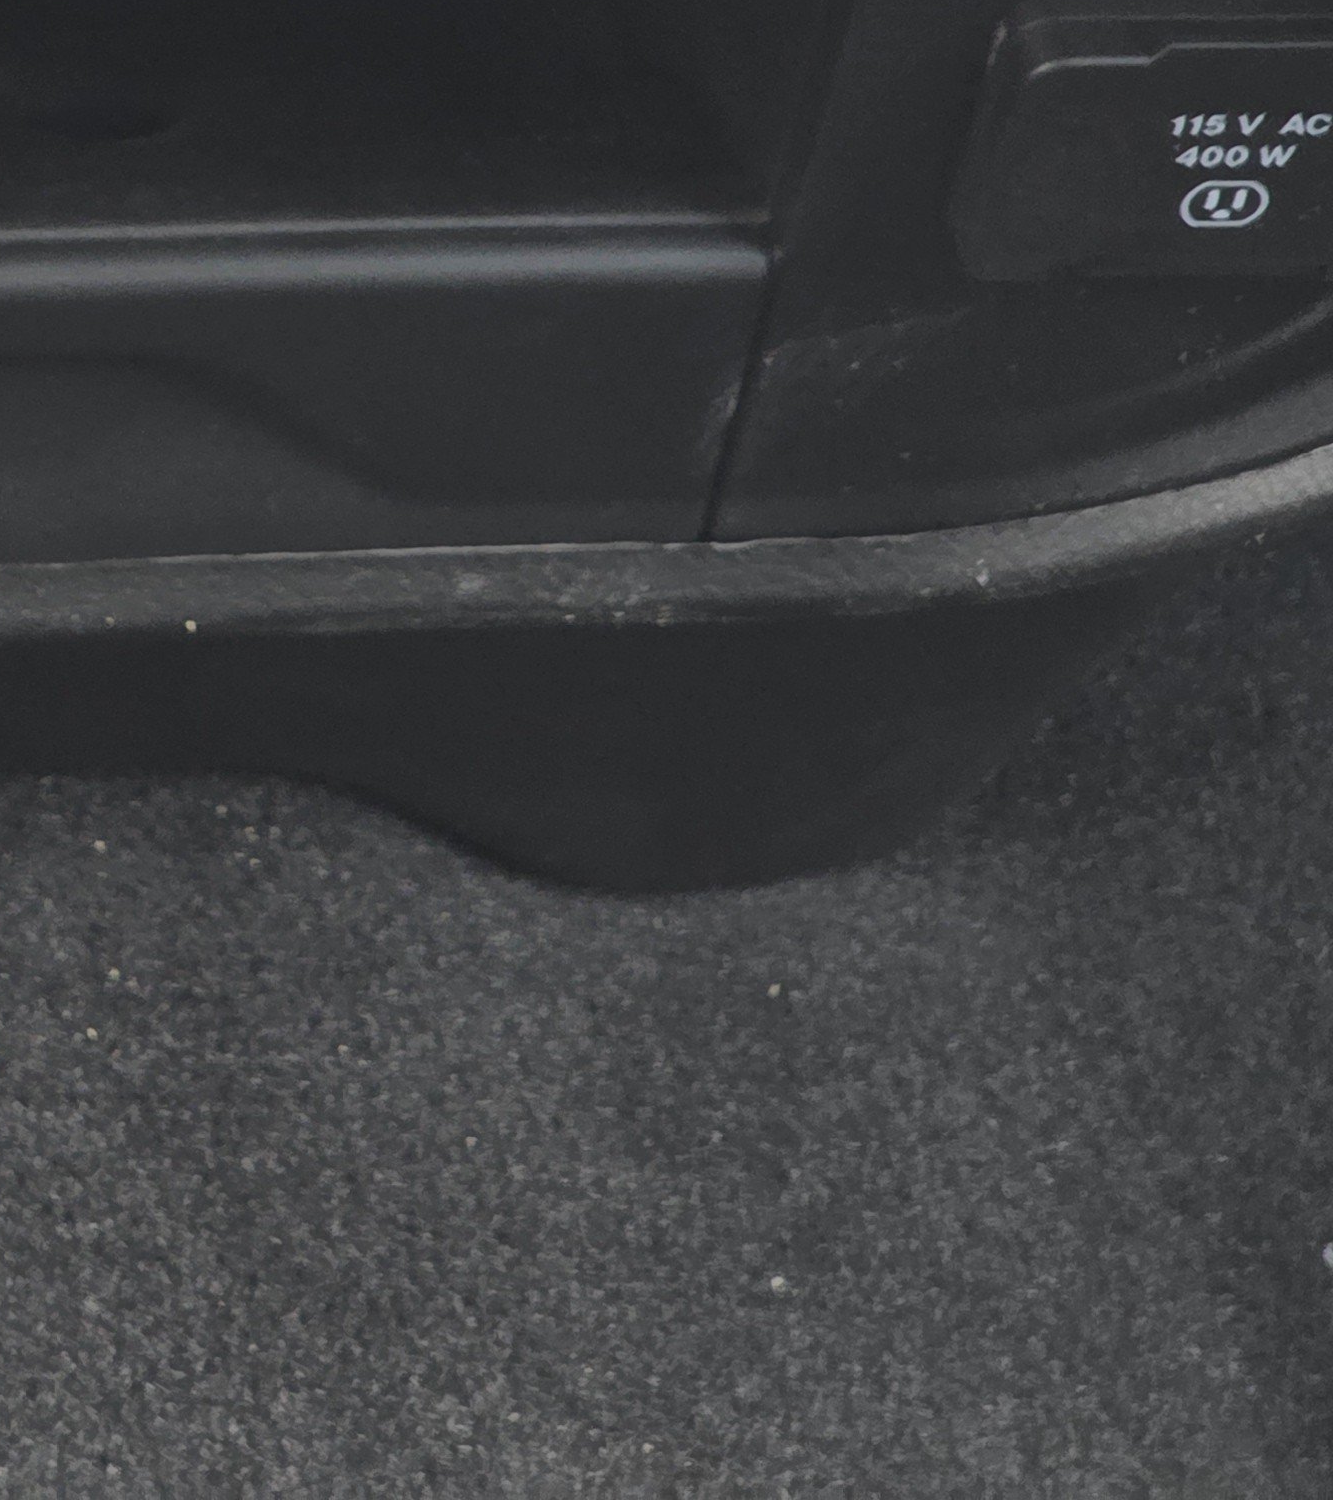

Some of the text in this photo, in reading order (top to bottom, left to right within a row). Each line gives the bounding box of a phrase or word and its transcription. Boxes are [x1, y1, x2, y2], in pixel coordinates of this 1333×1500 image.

[1171, 113, 1333, 137] 115 V AC
[1175, 144, 1297, 168] 400 W
